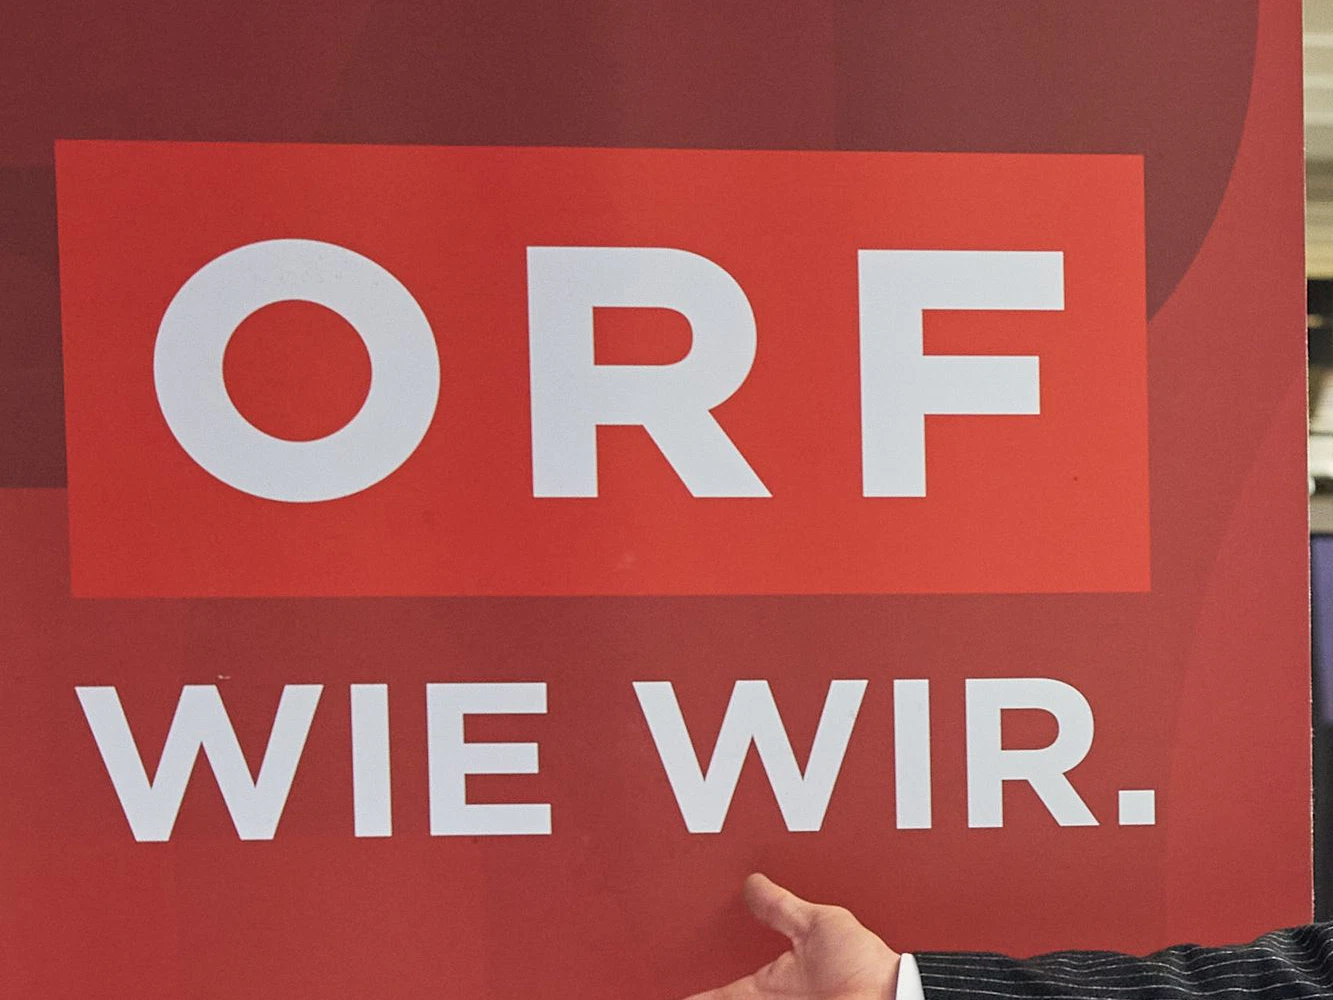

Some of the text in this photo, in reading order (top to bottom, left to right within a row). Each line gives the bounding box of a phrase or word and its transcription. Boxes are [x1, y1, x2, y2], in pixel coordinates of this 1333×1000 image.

[153, 238, 1065, 503] ORF
[74, 677, 1156, 842] WIE WIR.
